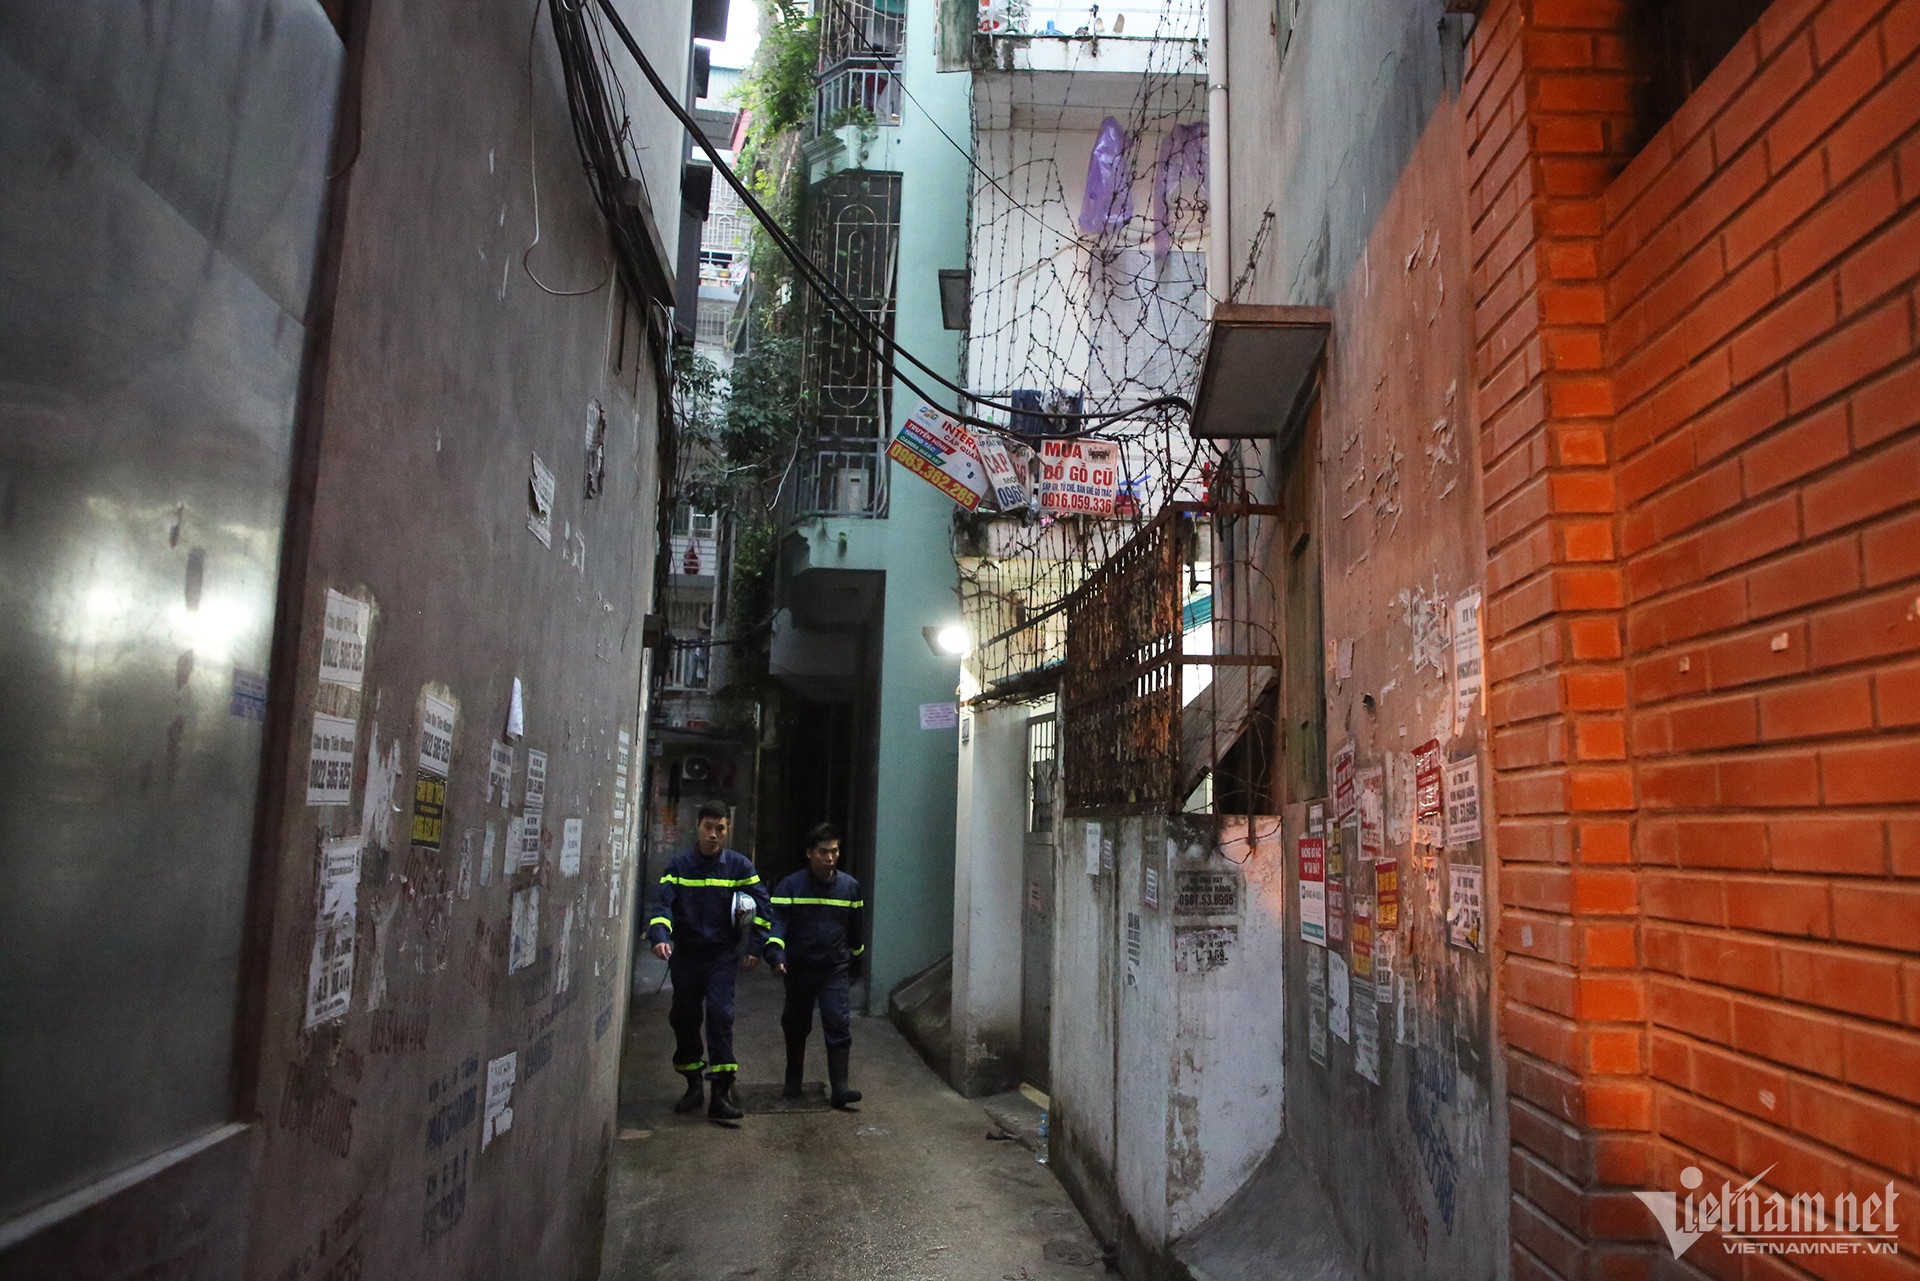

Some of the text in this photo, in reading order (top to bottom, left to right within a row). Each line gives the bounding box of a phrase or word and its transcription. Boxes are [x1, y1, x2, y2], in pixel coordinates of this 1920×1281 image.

[1044, 442, 1083, 459] MUA
[890, 443, 975, 506] 0963.362.285
[1069, 462, 1088, 483] GỖ
[1093, 467, 1113, 487] CŨ
[1041, 492, 1112, 513] 0916.059.336
